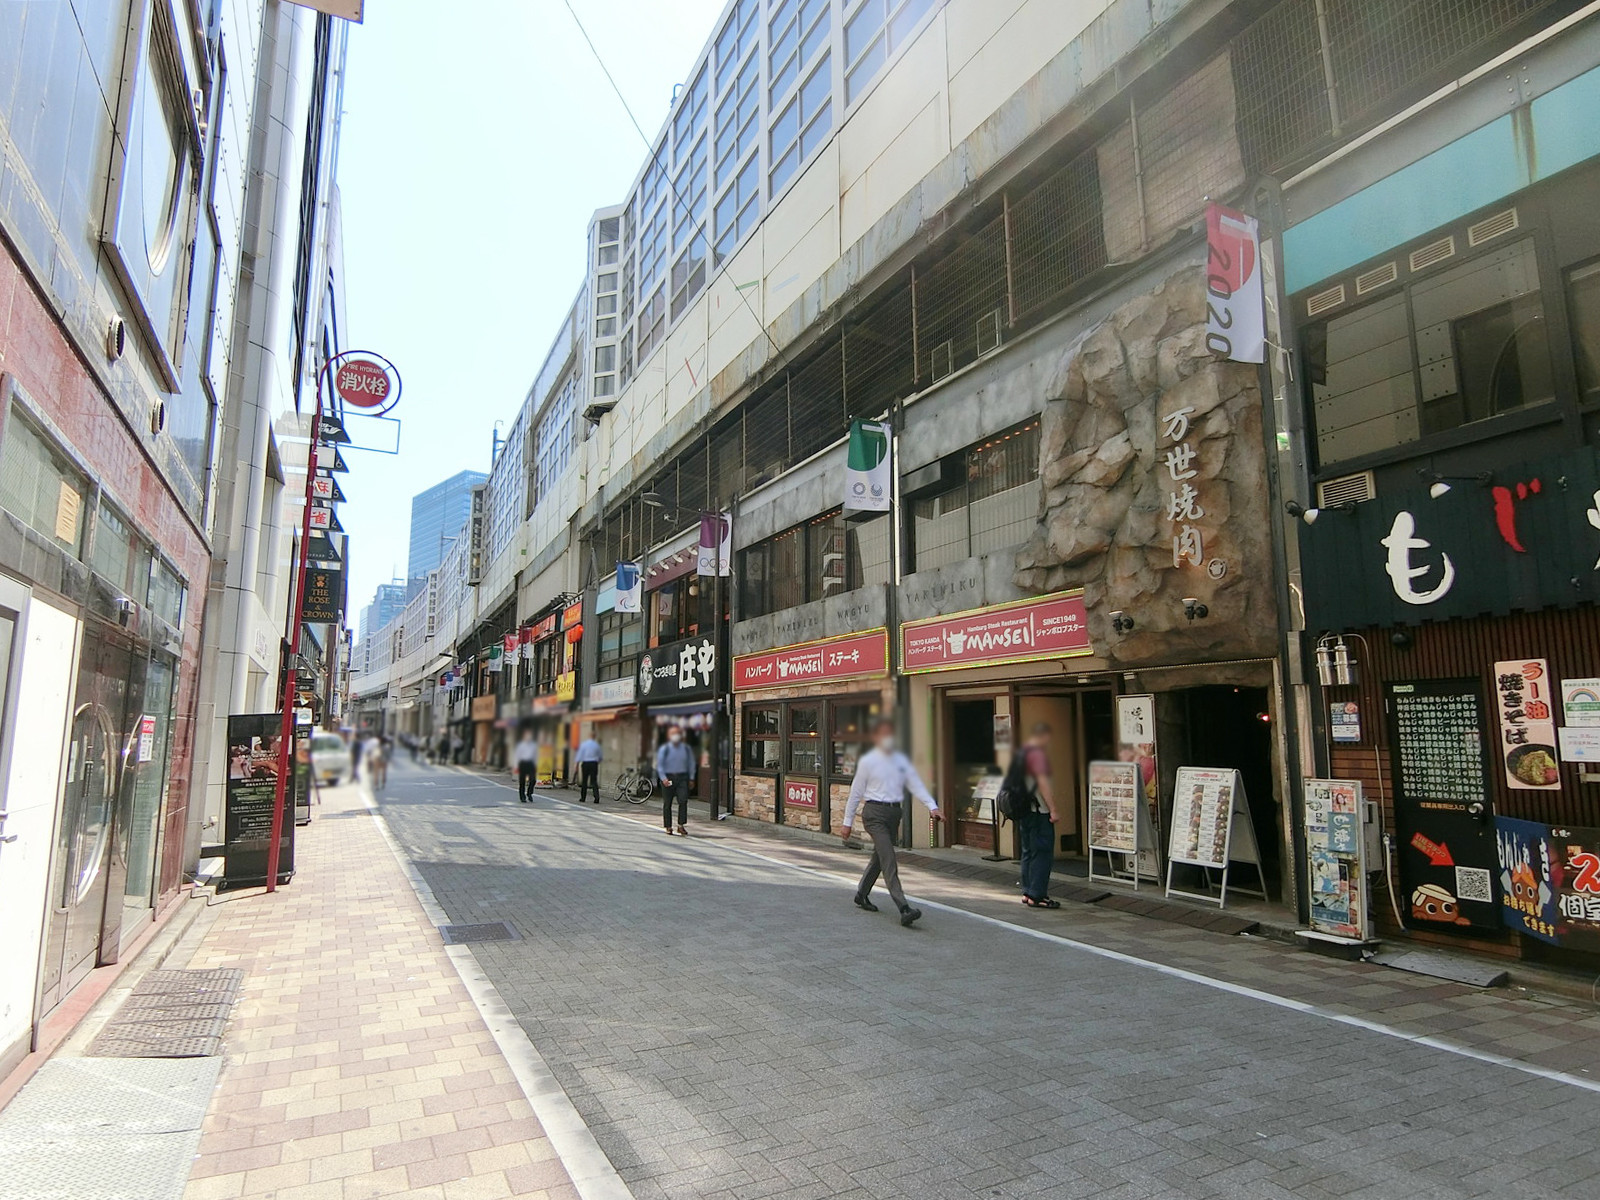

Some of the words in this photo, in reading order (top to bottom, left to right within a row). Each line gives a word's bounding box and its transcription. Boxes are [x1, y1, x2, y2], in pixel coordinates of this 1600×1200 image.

[1206, 242, 1233, 360] 2020
[360, 366, 383, 375] HYDRANT
[341, 371, 387, 397] 消火栓
[336, 458, 342, 468] 6
[334, 489, 339, 498] 5
[1162, 406, 1206, 568] 万世焼肉
[328, 550, 334, 559] 3
[308, 596, 330, 604] ROSE
[302, 610, 334, 618] CROWN
[1001, 617, 1028, 628] Restaurant
[966, 626, 1029, 652] MANSEI
[679, 639, 715, 689] 庄や
[829, 648, 860, 667] ステーキ
[745, 662, 773, 678] ハンバーグ
[789, 658, 820, 676] MANSEI
[1522, 661, 1550, 720] ラー油
[1498, 672, 1529, 745] 焼きそば
[788, 787, 814, 803] 肉の万世
[1522, 916, 1555, 938] できます
